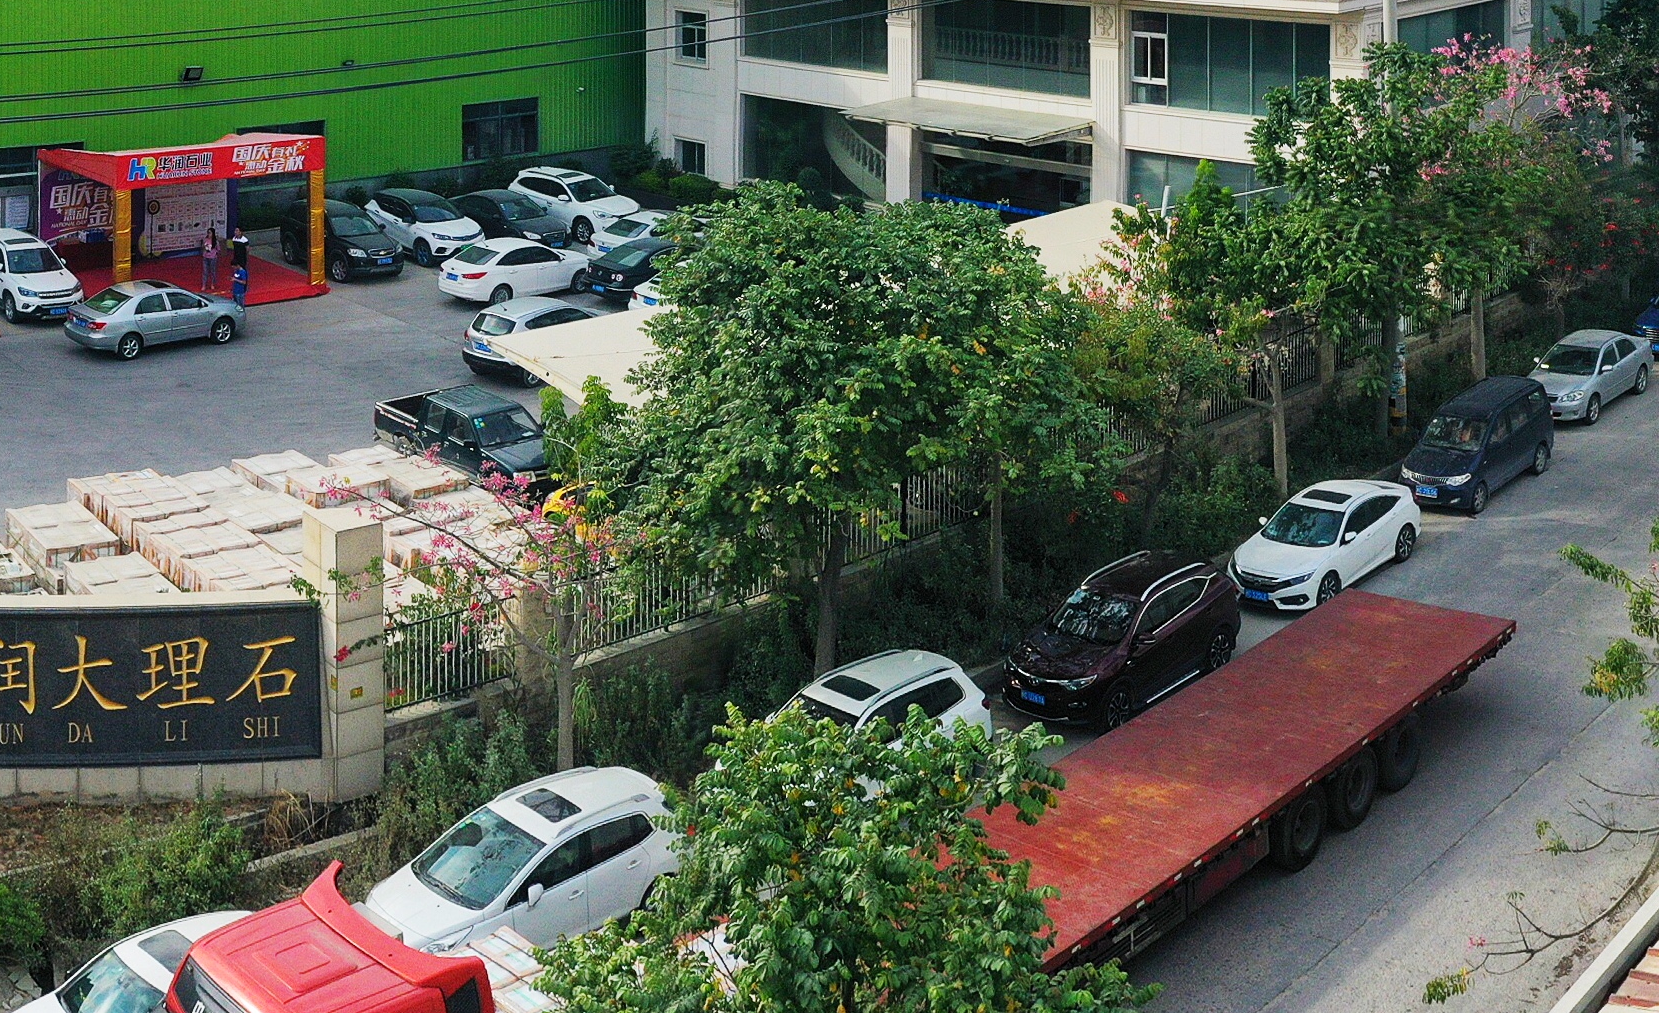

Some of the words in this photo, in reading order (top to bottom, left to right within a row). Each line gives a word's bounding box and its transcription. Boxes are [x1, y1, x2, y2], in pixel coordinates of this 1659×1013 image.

[157, 151, 214, 171] 华润石业
[67, 722, 94, 744] DA
[164, 718, 189, 741] LI
[243, 715, 282, 739] SHI
